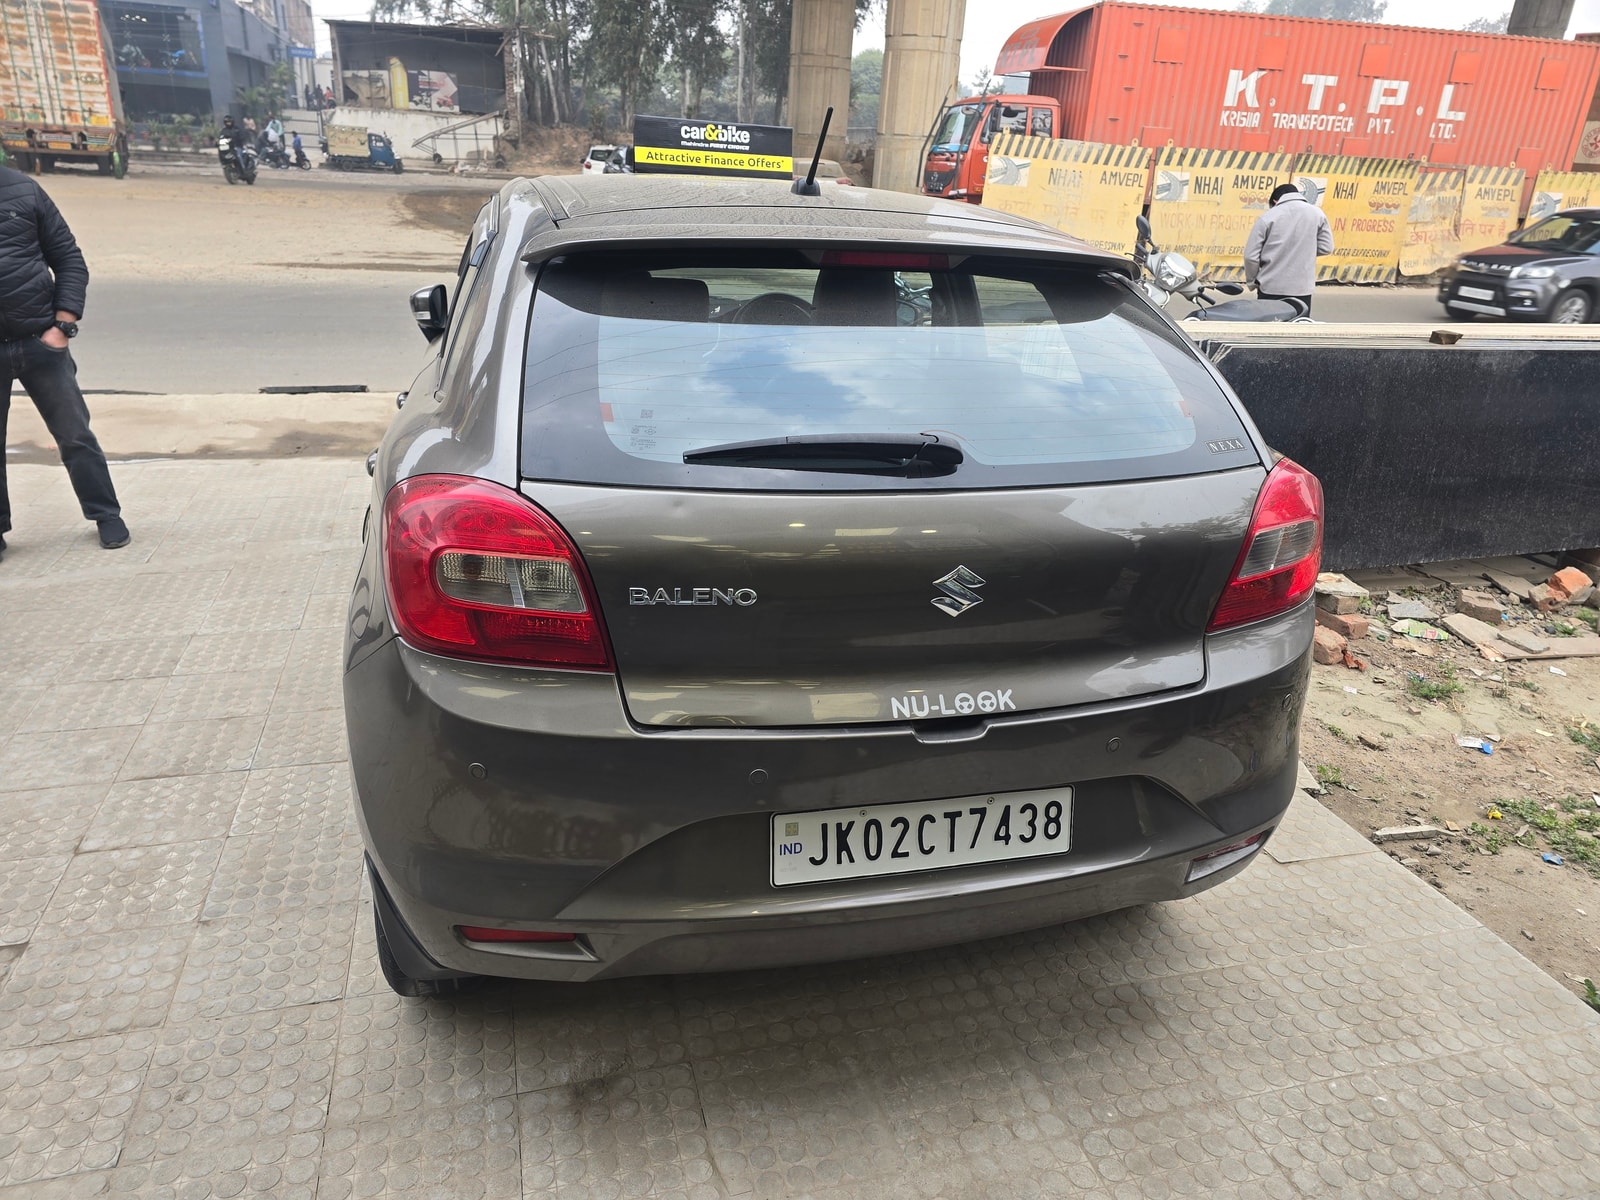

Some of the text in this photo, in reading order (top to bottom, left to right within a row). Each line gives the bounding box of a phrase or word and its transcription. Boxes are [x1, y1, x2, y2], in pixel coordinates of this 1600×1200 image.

[681, 123, 750, 144] car&bike
[1429, 122, 1457, 139] LTD.
[646, 151, 701, 164] Attractive
[704, 155, 744, 167] Finance
[1100, 170, 1144, 188] AMVEPL
[1193, 176, 1224, 195] NHAI
[1333, 181, 1408, 200] NHAI AMVEPL
[1475, 187, 1517, 202] AMVEPL
[1333, 217, 1395, 233] IN PROGRESS
[1209, 439, 1244, 452] NEXA
[629, 587, 758, 606] BALENO
[891, 688, 1016, 719] NU-LOOK
[779, 800, 1063, 867] IND JK02CT7438
